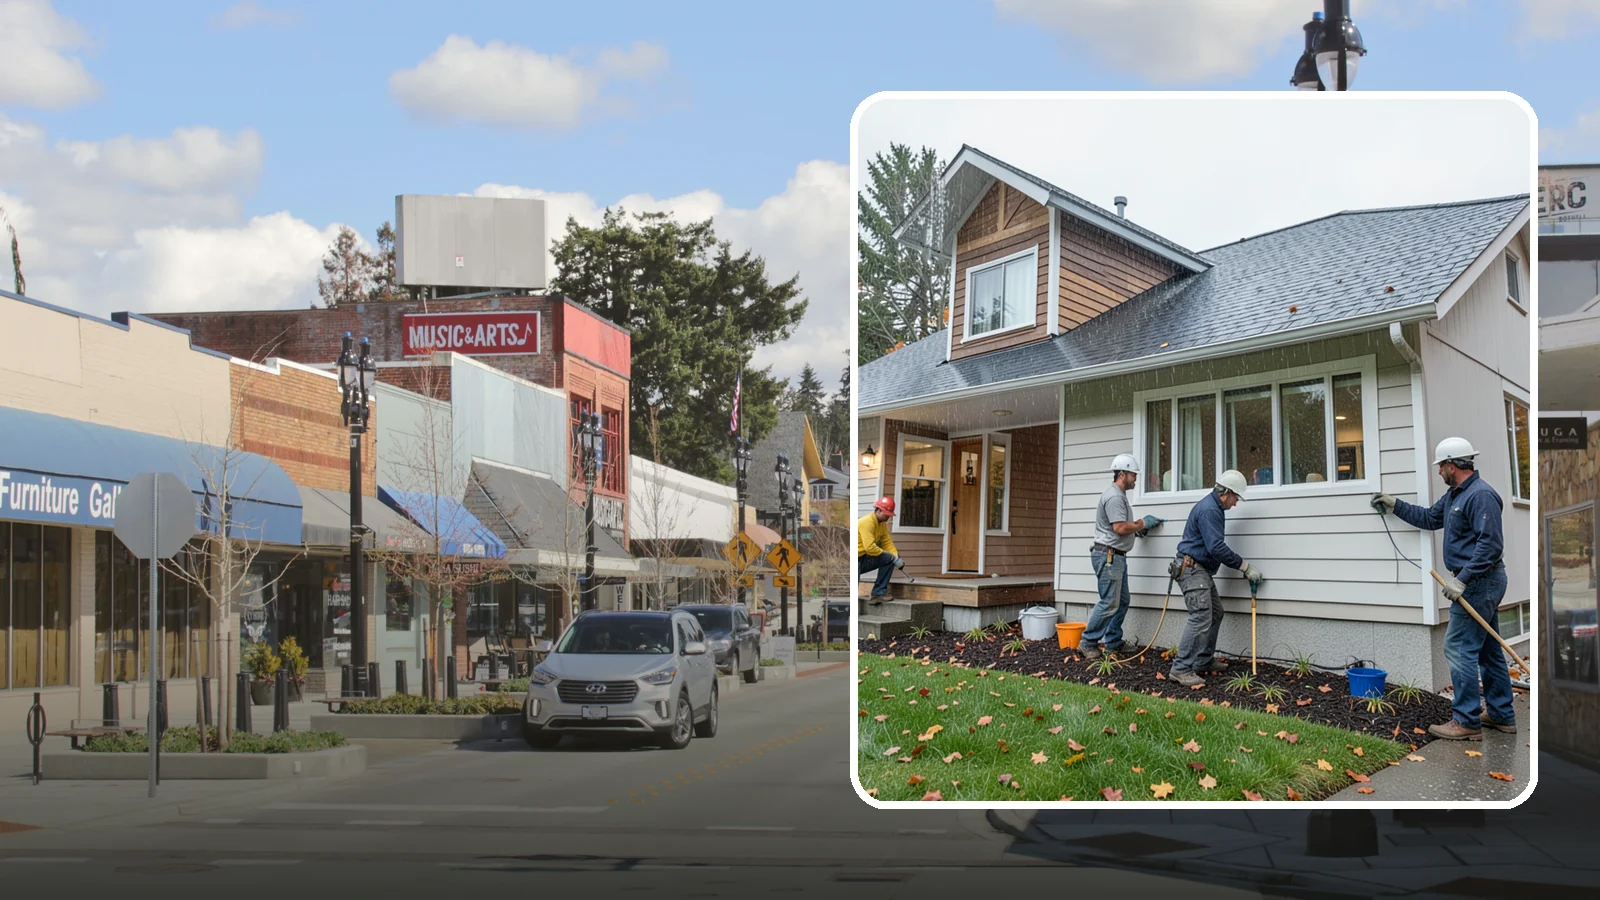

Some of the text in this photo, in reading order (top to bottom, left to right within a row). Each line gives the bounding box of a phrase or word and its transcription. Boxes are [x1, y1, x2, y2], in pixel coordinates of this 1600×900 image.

[1552, 436, 1579, 444] Framing
[0, 471, 122, 519] Furniture Gal
[453, 564, 479, 574] SUSHI
